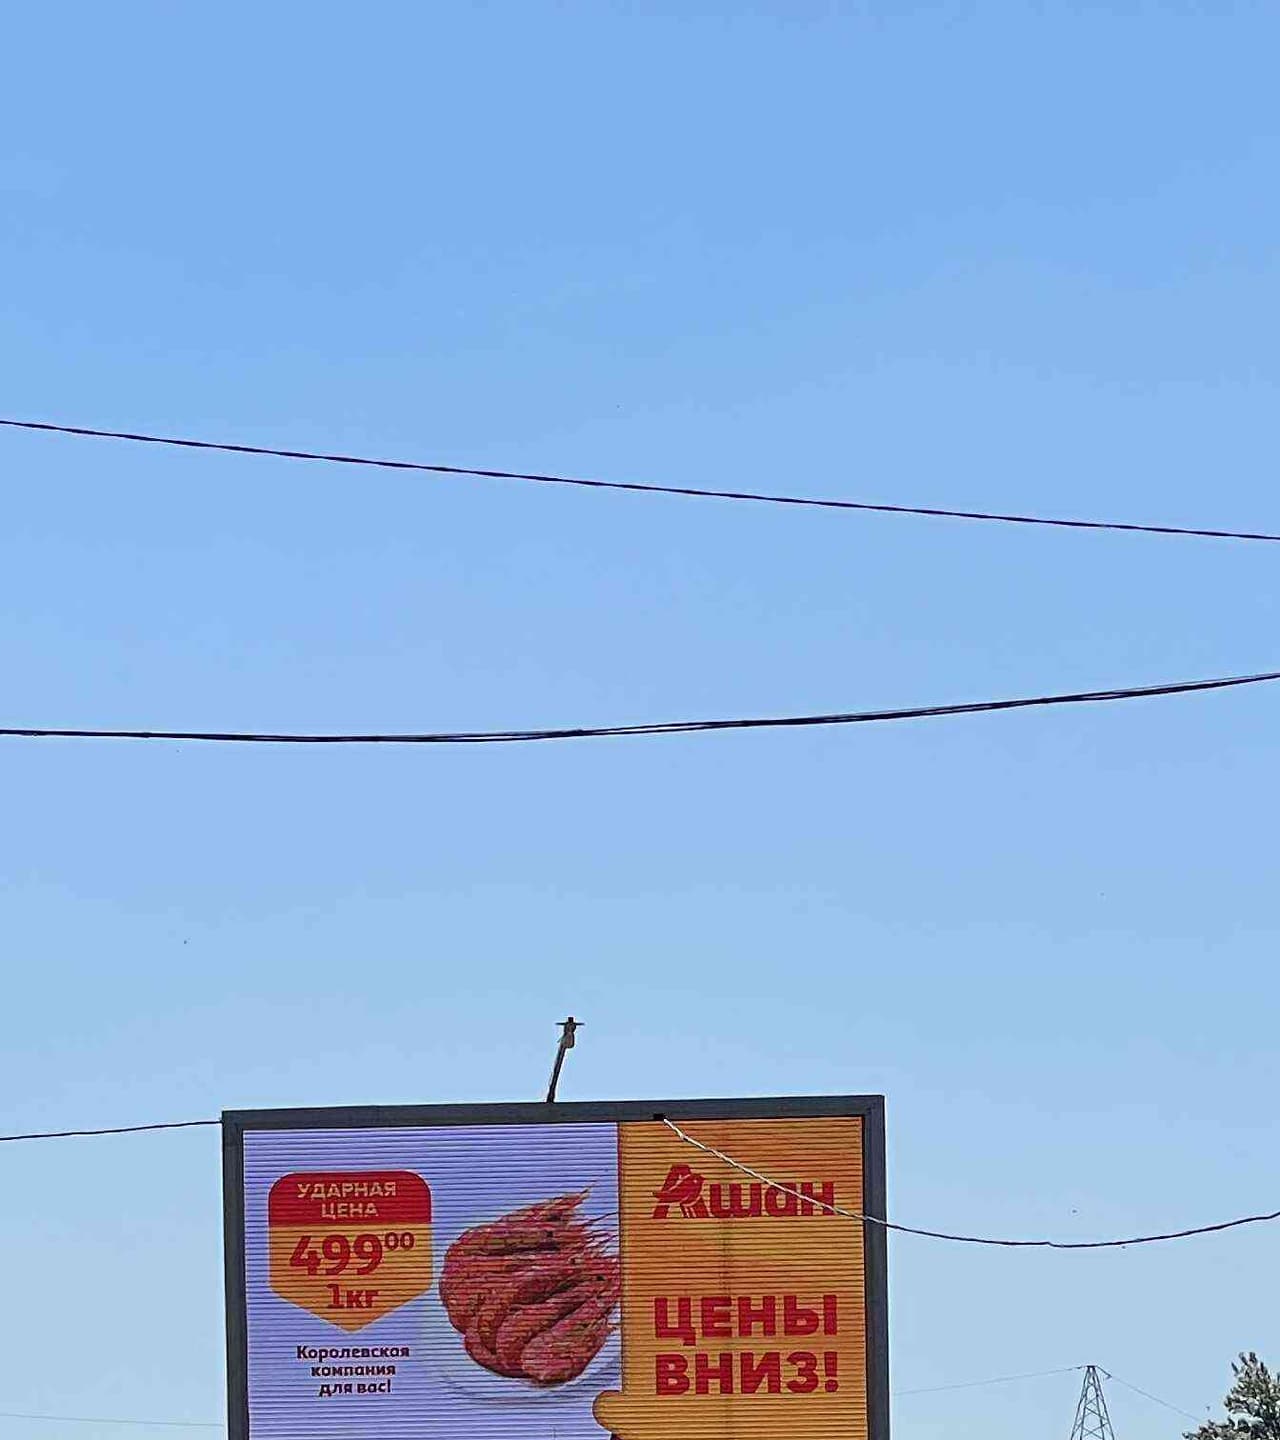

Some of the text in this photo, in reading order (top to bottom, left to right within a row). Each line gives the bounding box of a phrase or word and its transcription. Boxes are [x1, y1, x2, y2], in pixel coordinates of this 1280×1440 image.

[297, 1182, 396, 1200] УДАРНАЯ
[321, 1202, 379, 1219] ЦЕНА
[655, 1295, 837, 1346] ЦЕНЫ
[297, 1345, 410, 1362] Королевская
[311, 1364, 396, 1377] компания
[656, 1352, 838, 1395] ВНИЗ!
[319, 1379, 391, 1397] для вас!
